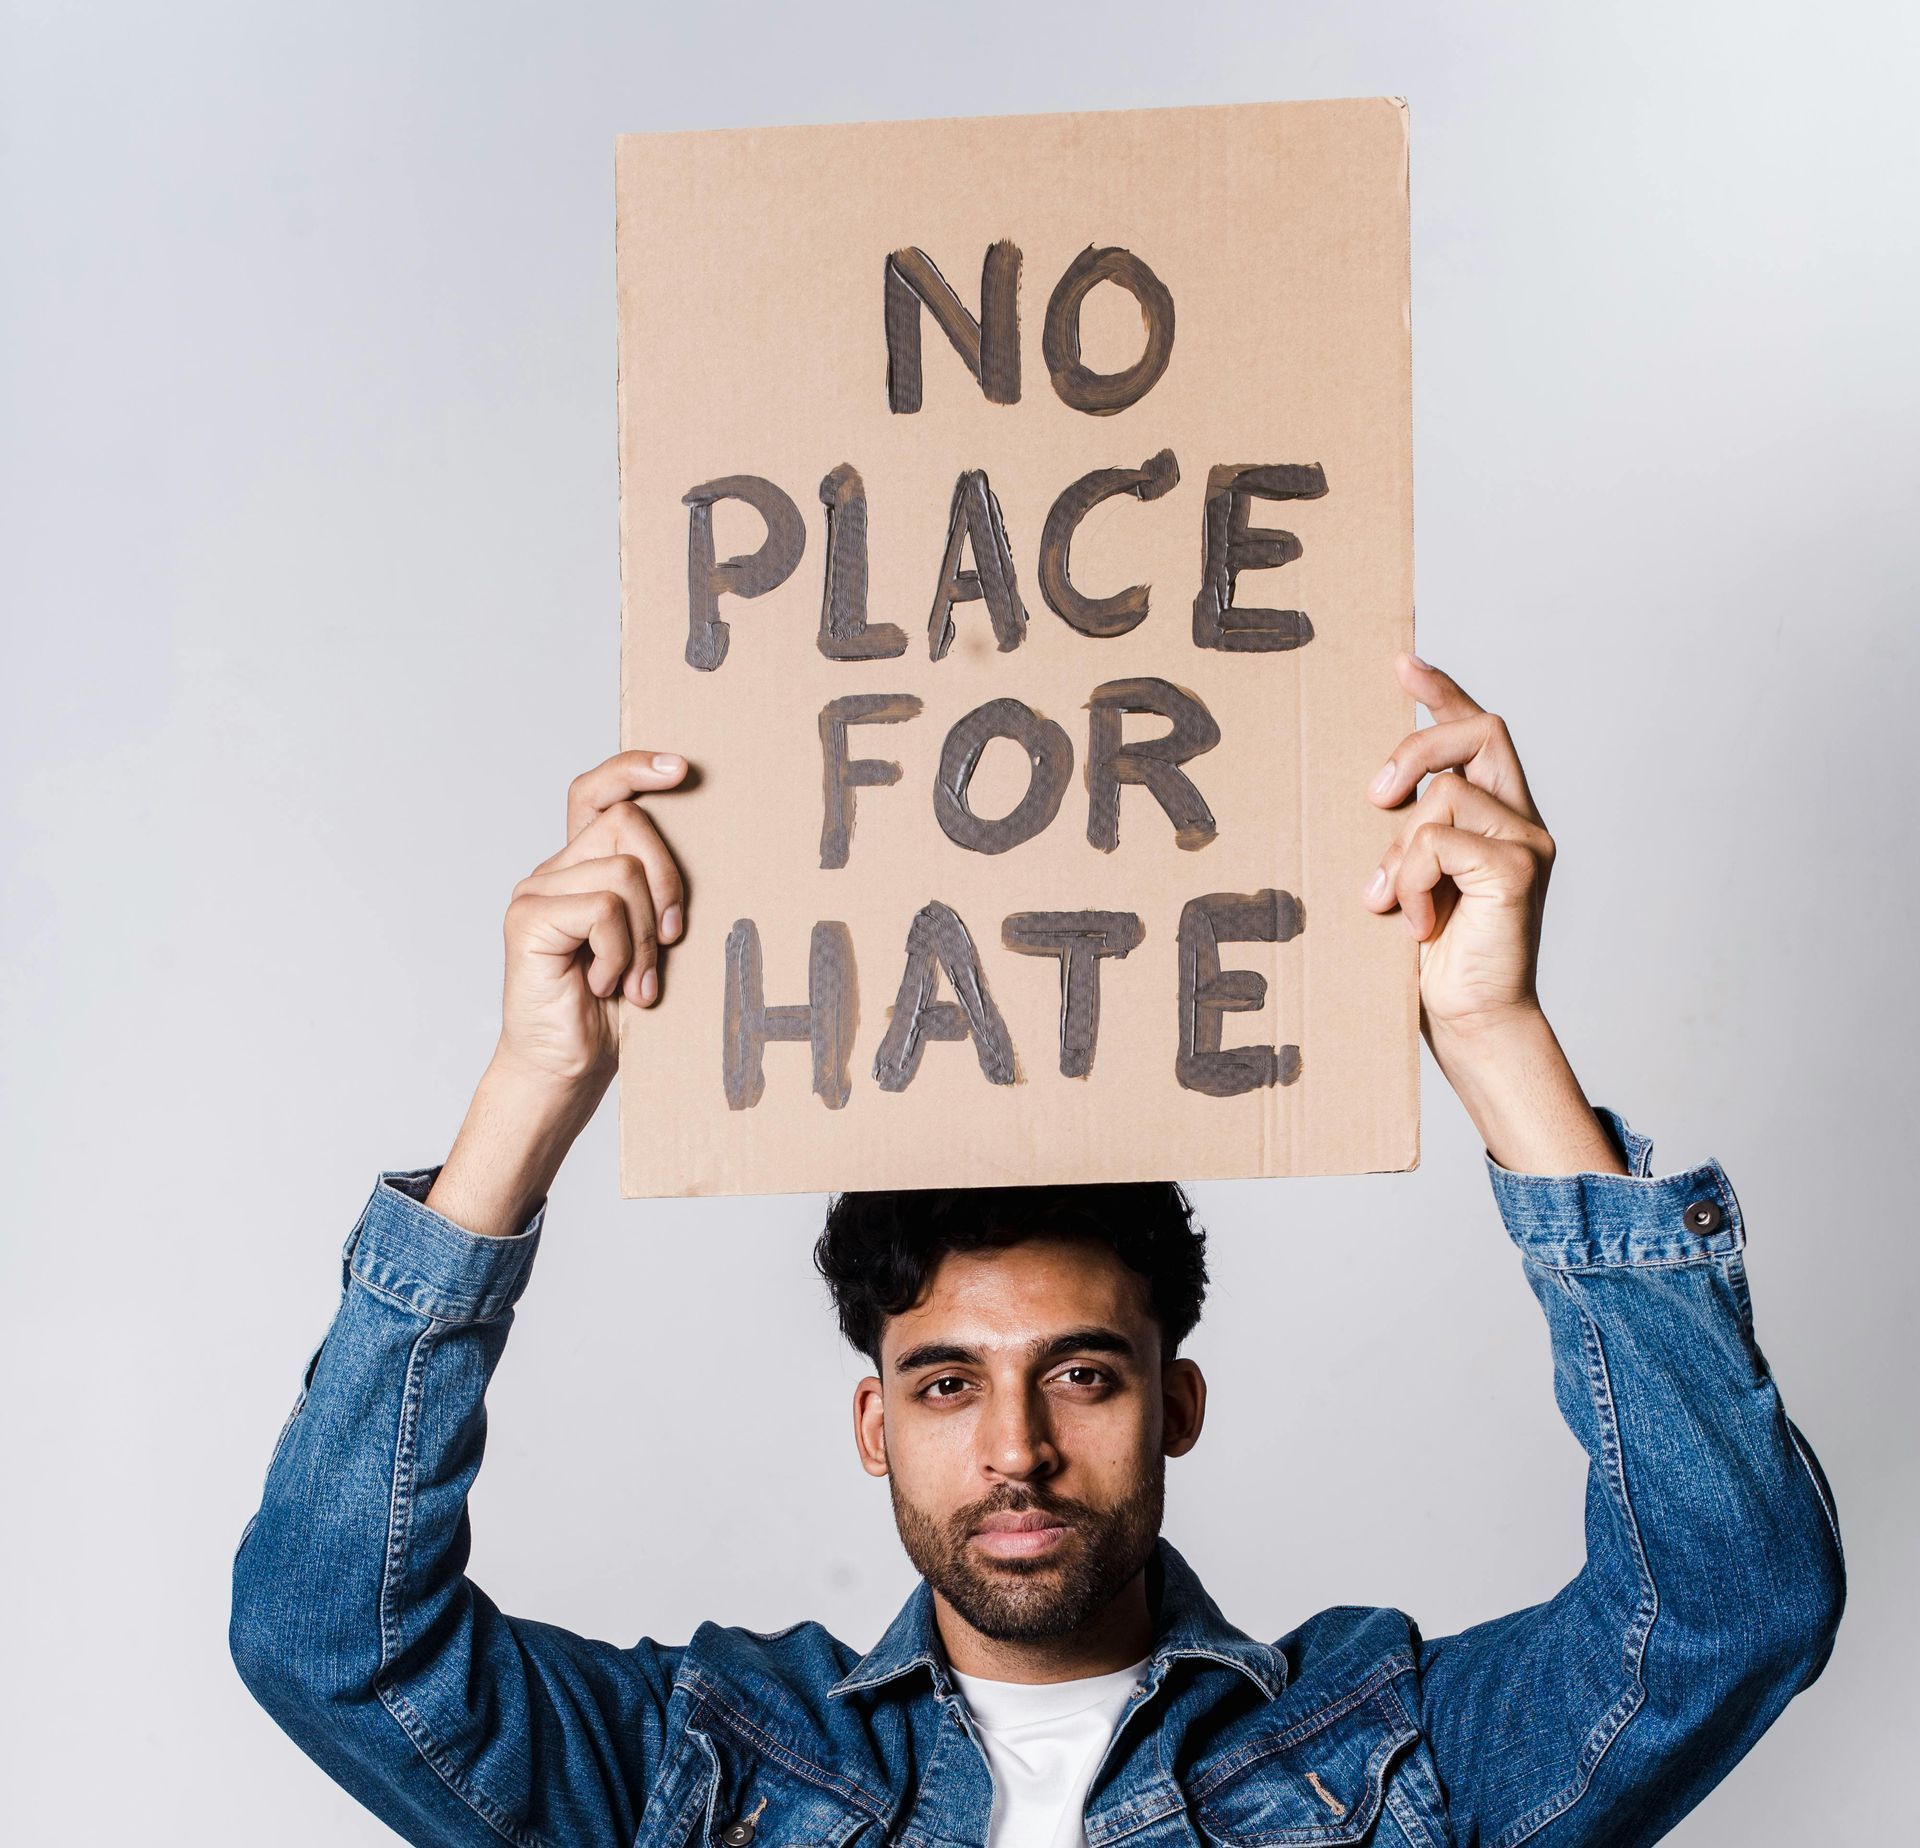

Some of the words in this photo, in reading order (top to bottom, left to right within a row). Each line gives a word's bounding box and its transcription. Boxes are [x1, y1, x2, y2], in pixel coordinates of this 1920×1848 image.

[884, 238, 1176, 417] NO
[682, 448, 1329, 672] PLACE
[818, 677, 1221, 869] FOR
[724, 888, 1306, 1110] HATE
